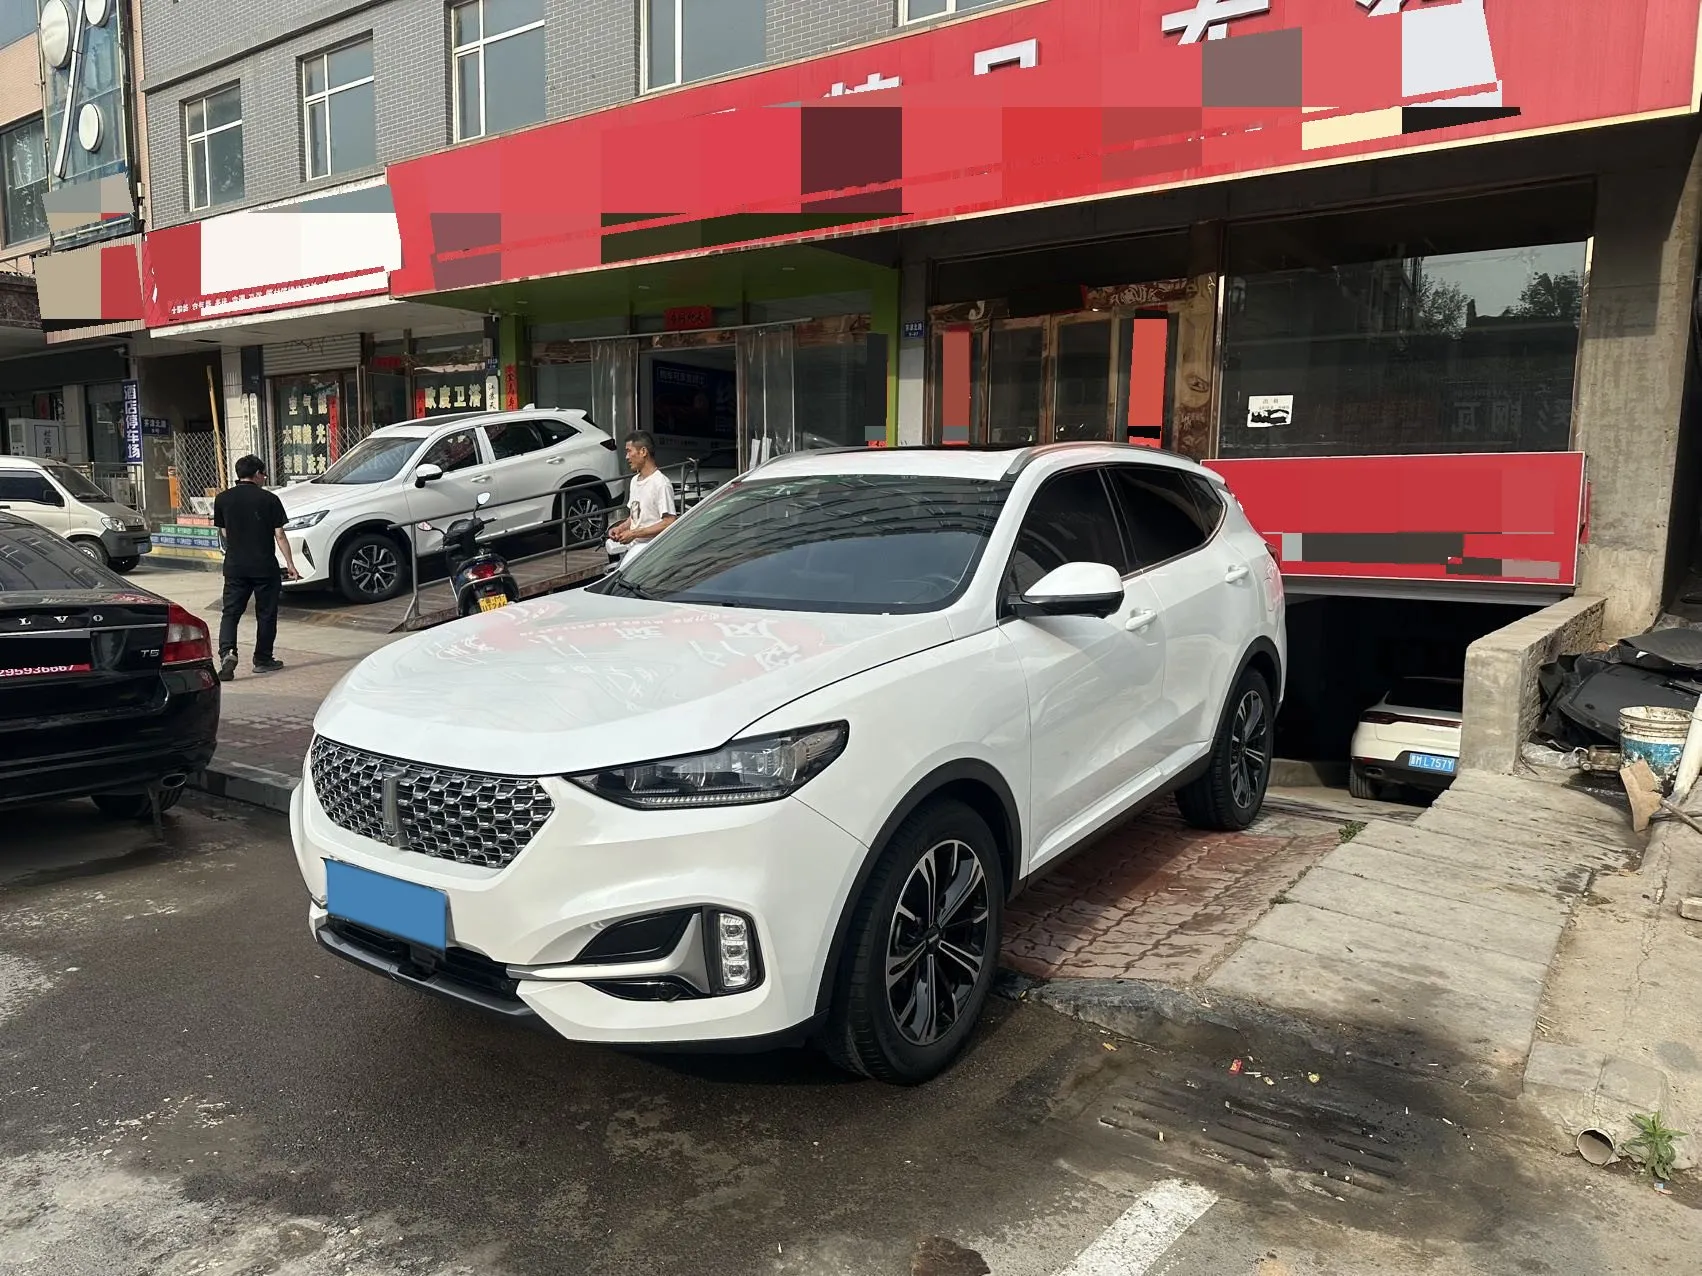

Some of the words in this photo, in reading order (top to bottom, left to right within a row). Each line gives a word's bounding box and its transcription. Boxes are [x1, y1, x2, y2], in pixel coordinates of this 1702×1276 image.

[124, 384, 140, 458] 酒店停车场
[282, 423, 312, 444] 太阳能
[141, 649, 160, 657] T5
